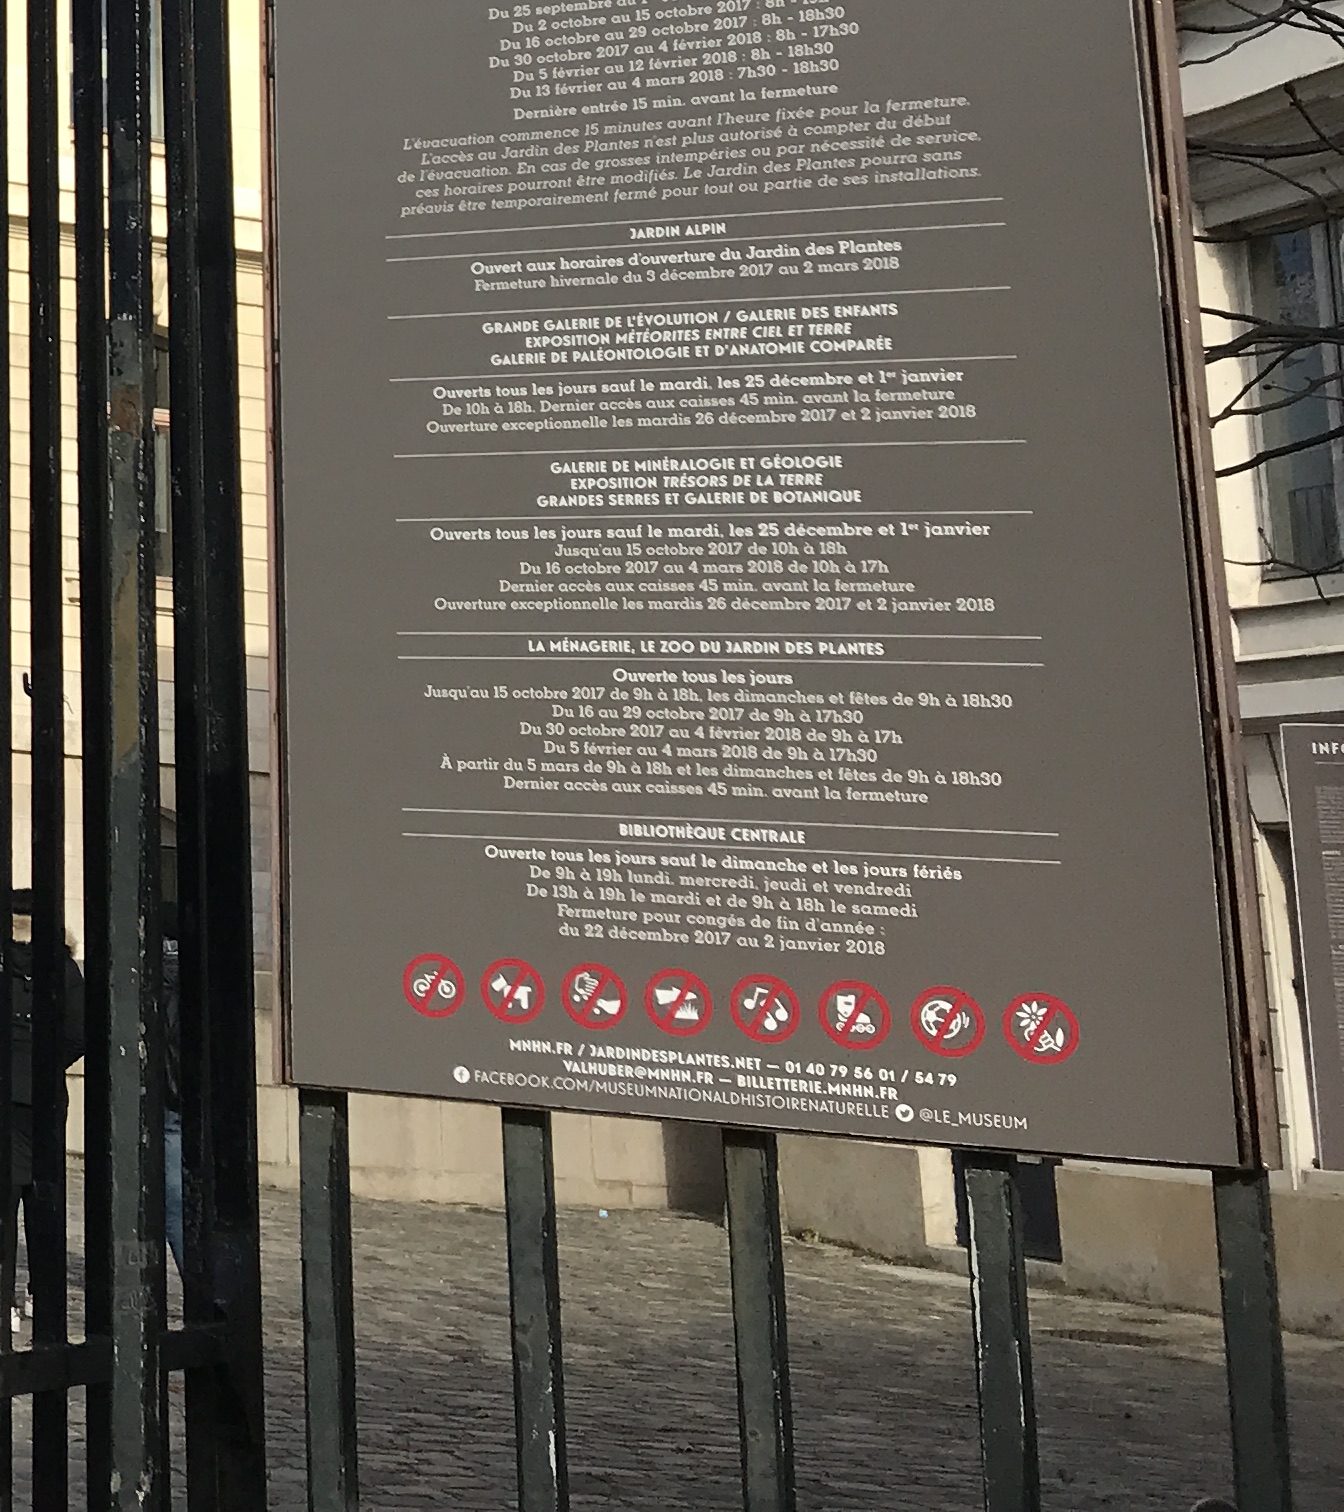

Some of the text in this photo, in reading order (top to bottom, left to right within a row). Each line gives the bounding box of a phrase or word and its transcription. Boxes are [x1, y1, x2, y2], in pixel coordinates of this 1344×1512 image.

[629, 222, 727, 240] JARDIN ALPIN
[470, 239, 903, 275] Ouvert aux horaires d'ouverture du Jardin des Plantes
[481, 302, 899, 335] GRANDE GALERIE DE L'ÉVOLUTION GALERIE DES ENFANTS
[525, 322, 853, 349] EXPOSITION MÉTÉORITES ENTRE CIEL ET TERRE
[489, 334, 893, 366] GALERIE DE PALÉONTOLOGIE ET D'ANATOMIE COMPARÉE
[527, 636, 885, 656] LA MÉNAGERIE, LE ZOO DU JARDIN DES PLANTES
[1312, 742, 1344, 755] INF
[618, 822, 806, 845] BIBLIOTHÈQUE CENTRALE
[508, 1038, 957, 1087] MNHN.FR JARDINDESPLANTES.NET 01 40 79 56 01 54 79
[562, 1059, 899, 1101] VALHUBER@MNHN.FR BILLETTERIE.MNHN.FR
[919, 1107, 1028, 1130] @LE_MUSEUM
